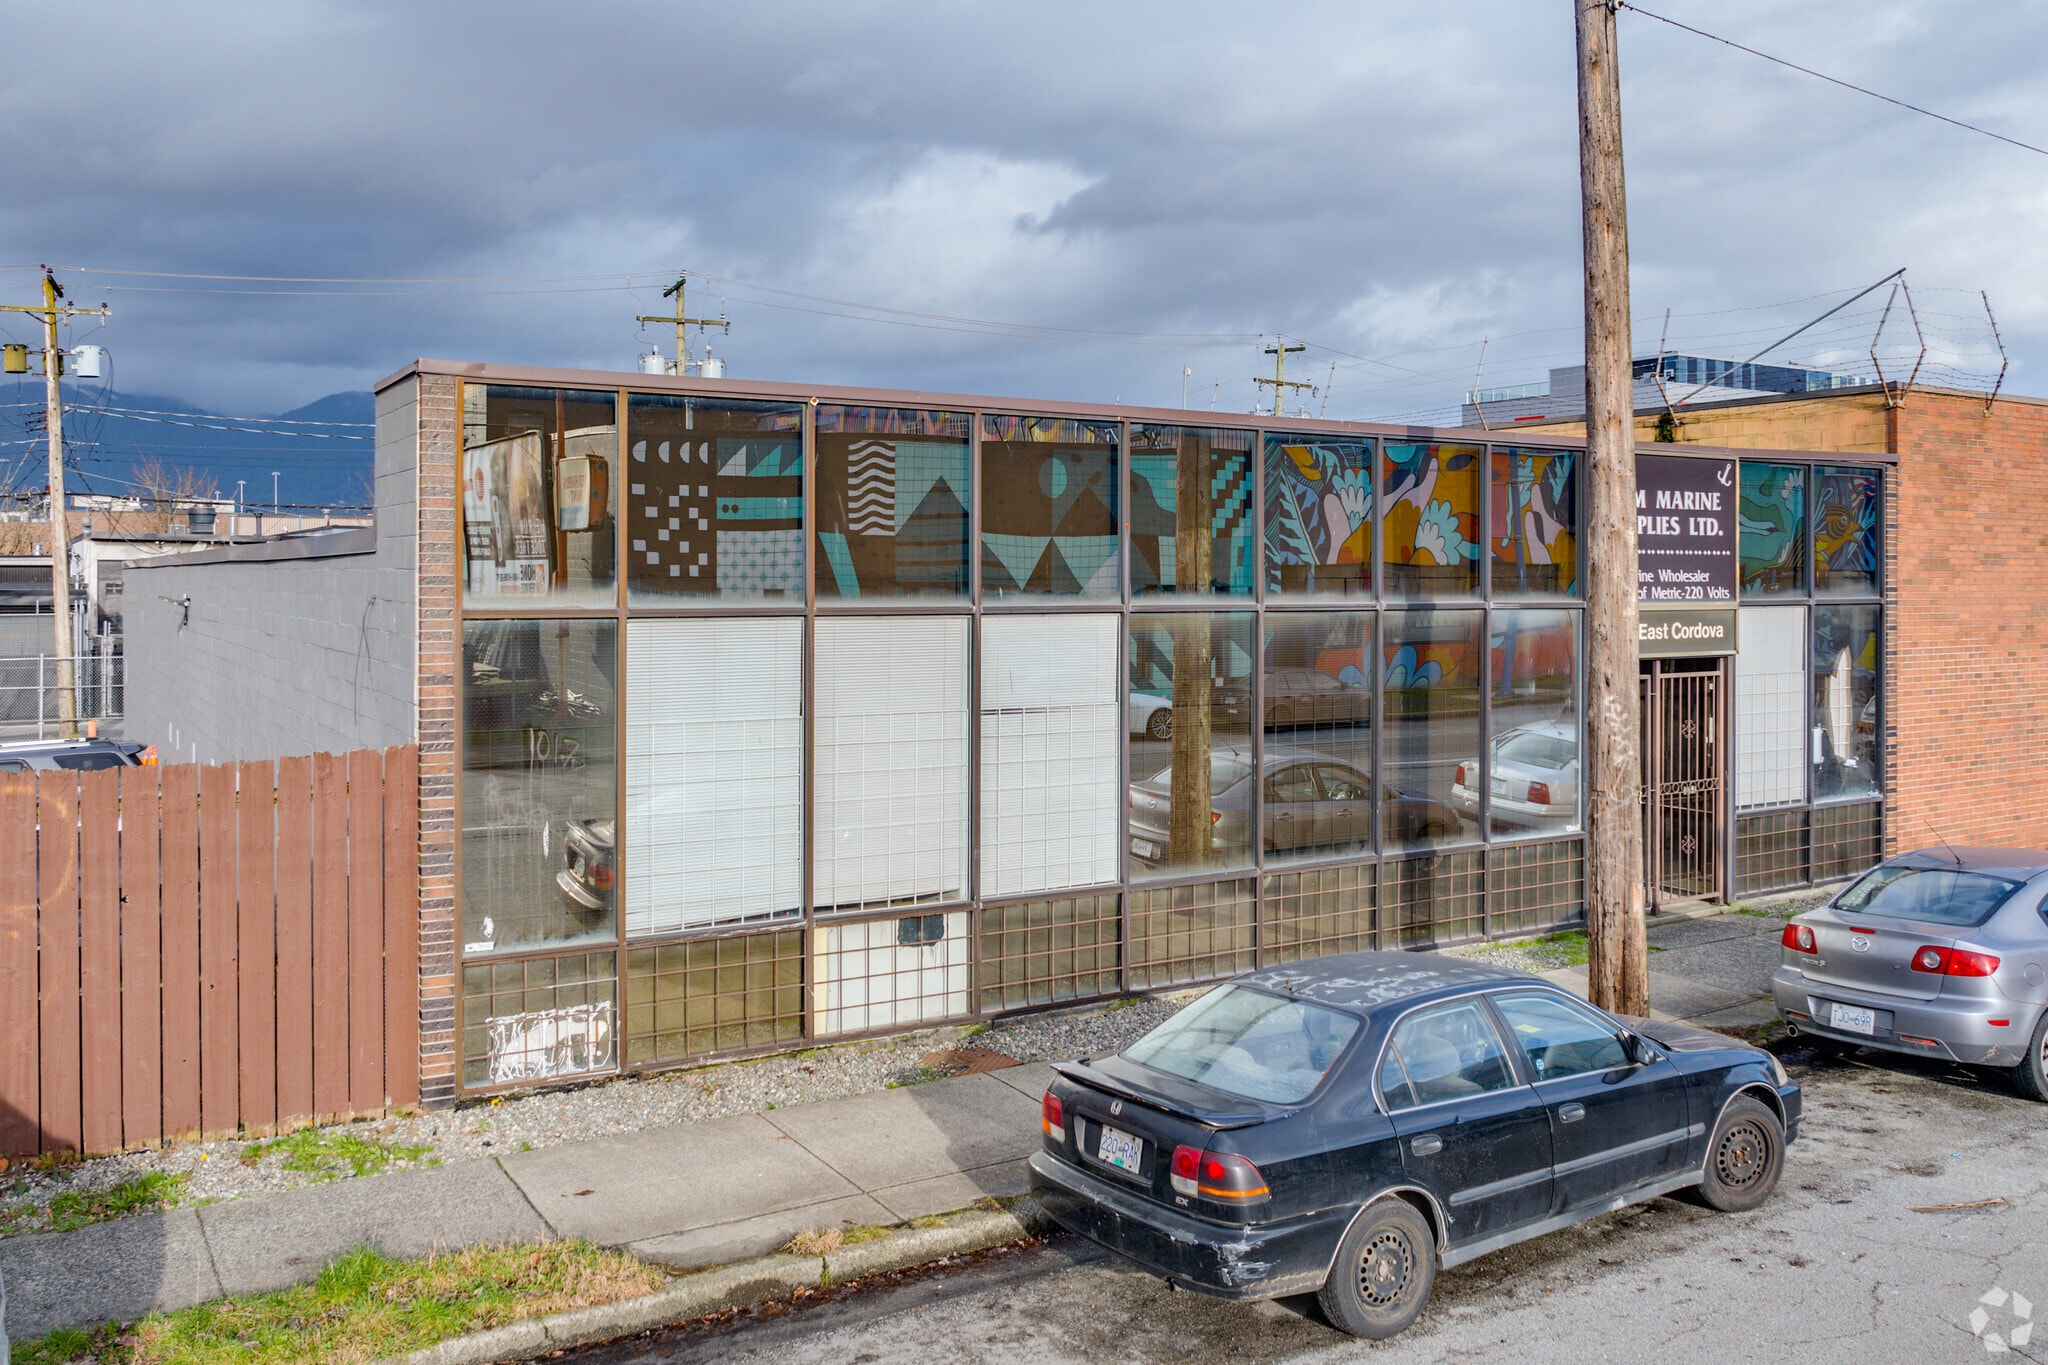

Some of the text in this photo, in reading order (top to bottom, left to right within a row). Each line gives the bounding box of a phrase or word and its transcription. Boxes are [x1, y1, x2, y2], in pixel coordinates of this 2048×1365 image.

[1655, 490, 1722, 511] MARINE
[1637, 515, 1724, 536] PLIES LTD.
[1638, 569, 1710, 582] ine Wholesaler
[1651, 586, 1704, 599] Metric-220
[1706, 586, 1731, 599] Volts
[1638, 622, 1724, 640] East Cordova
